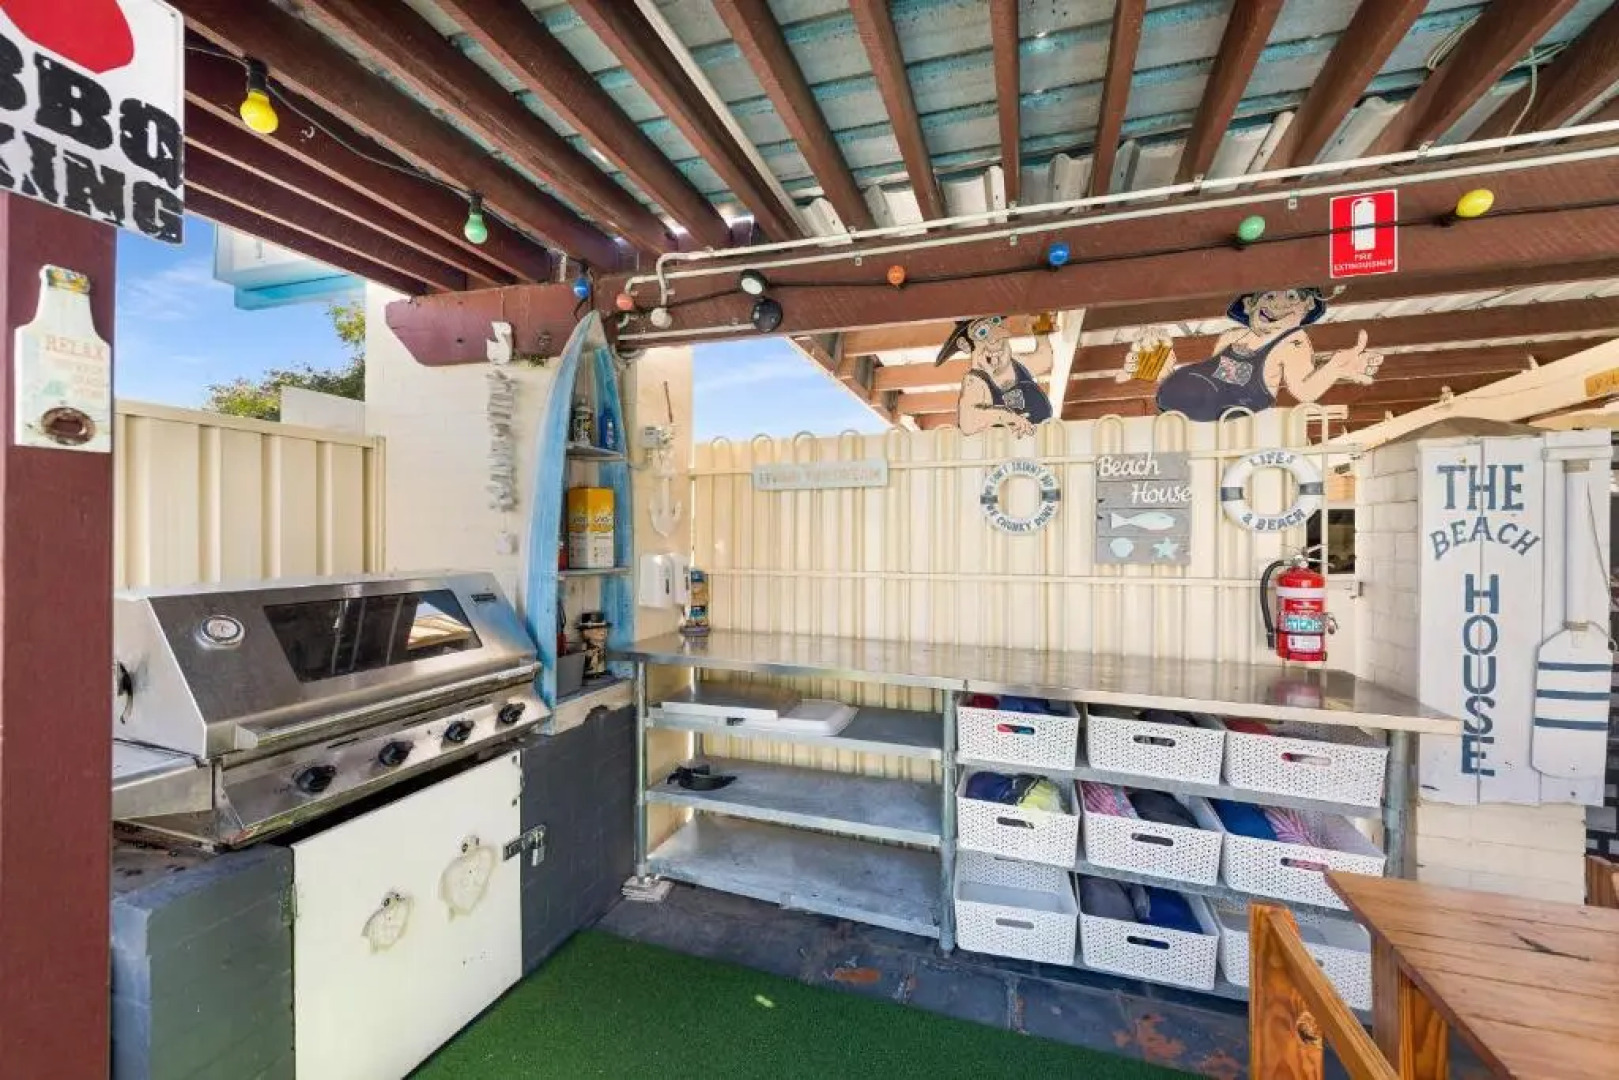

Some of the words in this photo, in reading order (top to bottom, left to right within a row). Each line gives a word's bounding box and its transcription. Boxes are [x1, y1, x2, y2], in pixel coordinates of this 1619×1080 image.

[1333, 258, 1394, 272] EXTINGUISHER
[1354, 252, 1373, 261] FIRE
[46, 334, 105, 361] RELAX
[1097, 453, 1161, 477] Beach
[1131, 481, 1193, 504] House
[1437, 464, 1525, 511] THE
[1254, 508, 1307, 531] BEACH
[1430, 516, 1541, 561] BEACH
[1461, 573, 1500, 777] HOUSE
